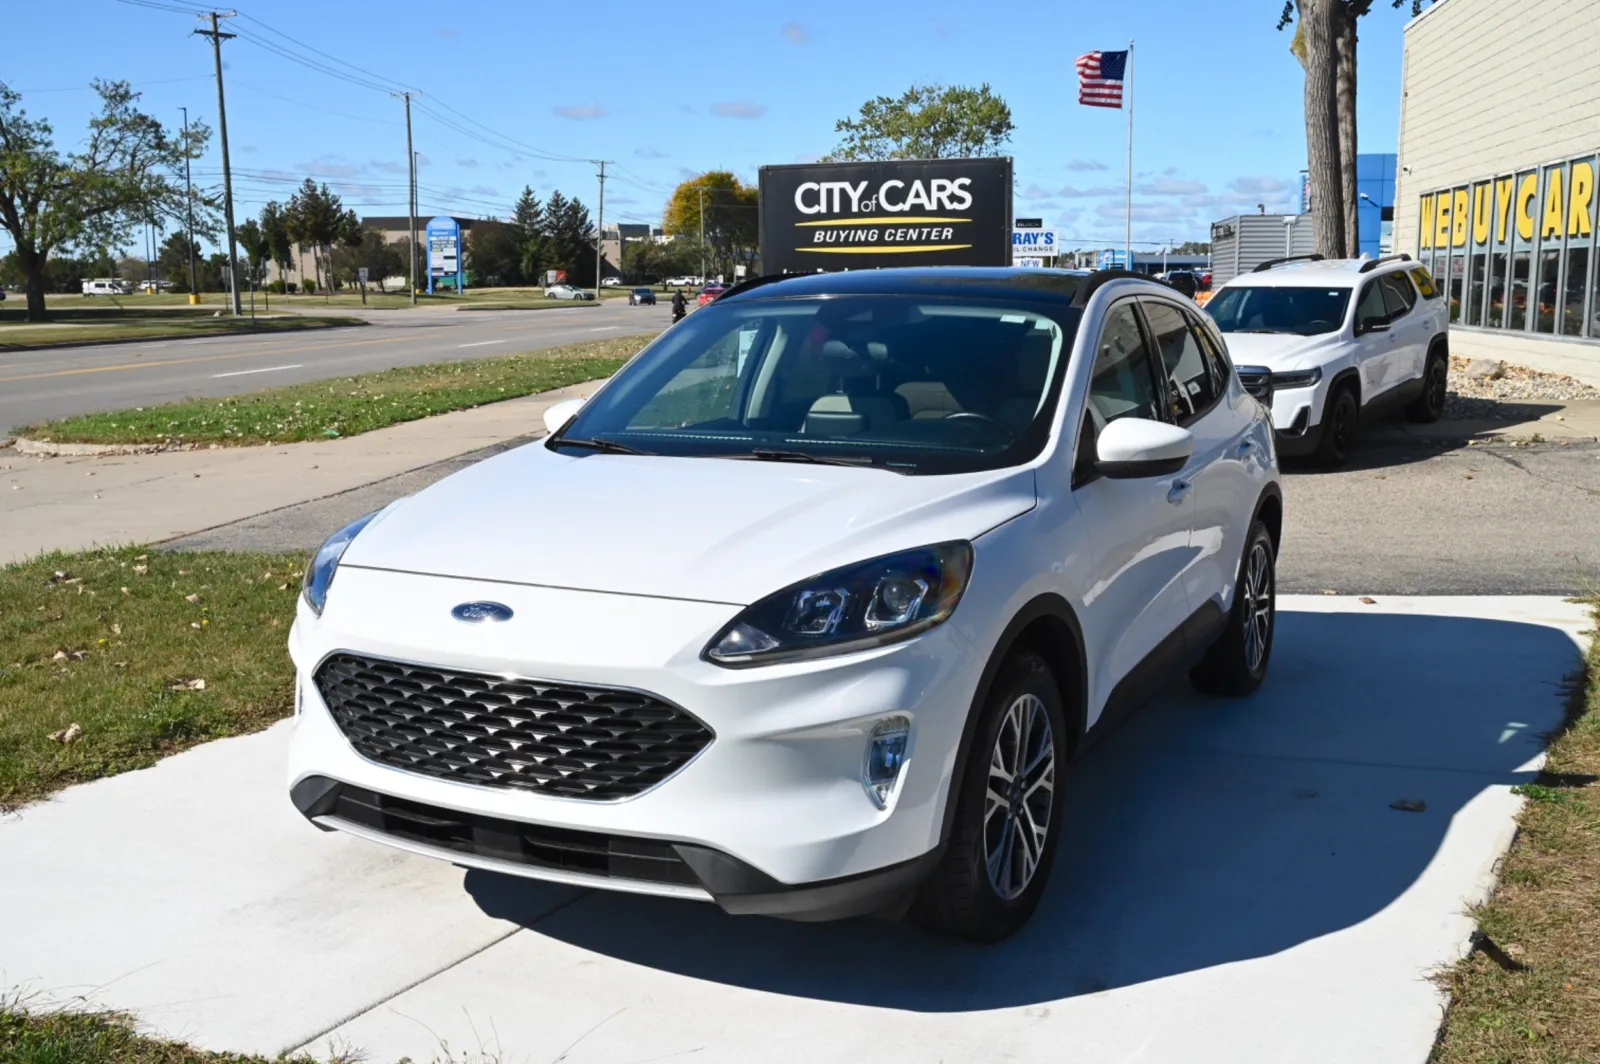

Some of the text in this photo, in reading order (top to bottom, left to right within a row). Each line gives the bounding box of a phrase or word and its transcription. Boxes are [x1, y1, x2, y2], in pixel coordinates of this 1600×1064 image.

[795, 177, 973, 214] CITY of CARS
[813, 227, 954, 243] BUYING CENTER
